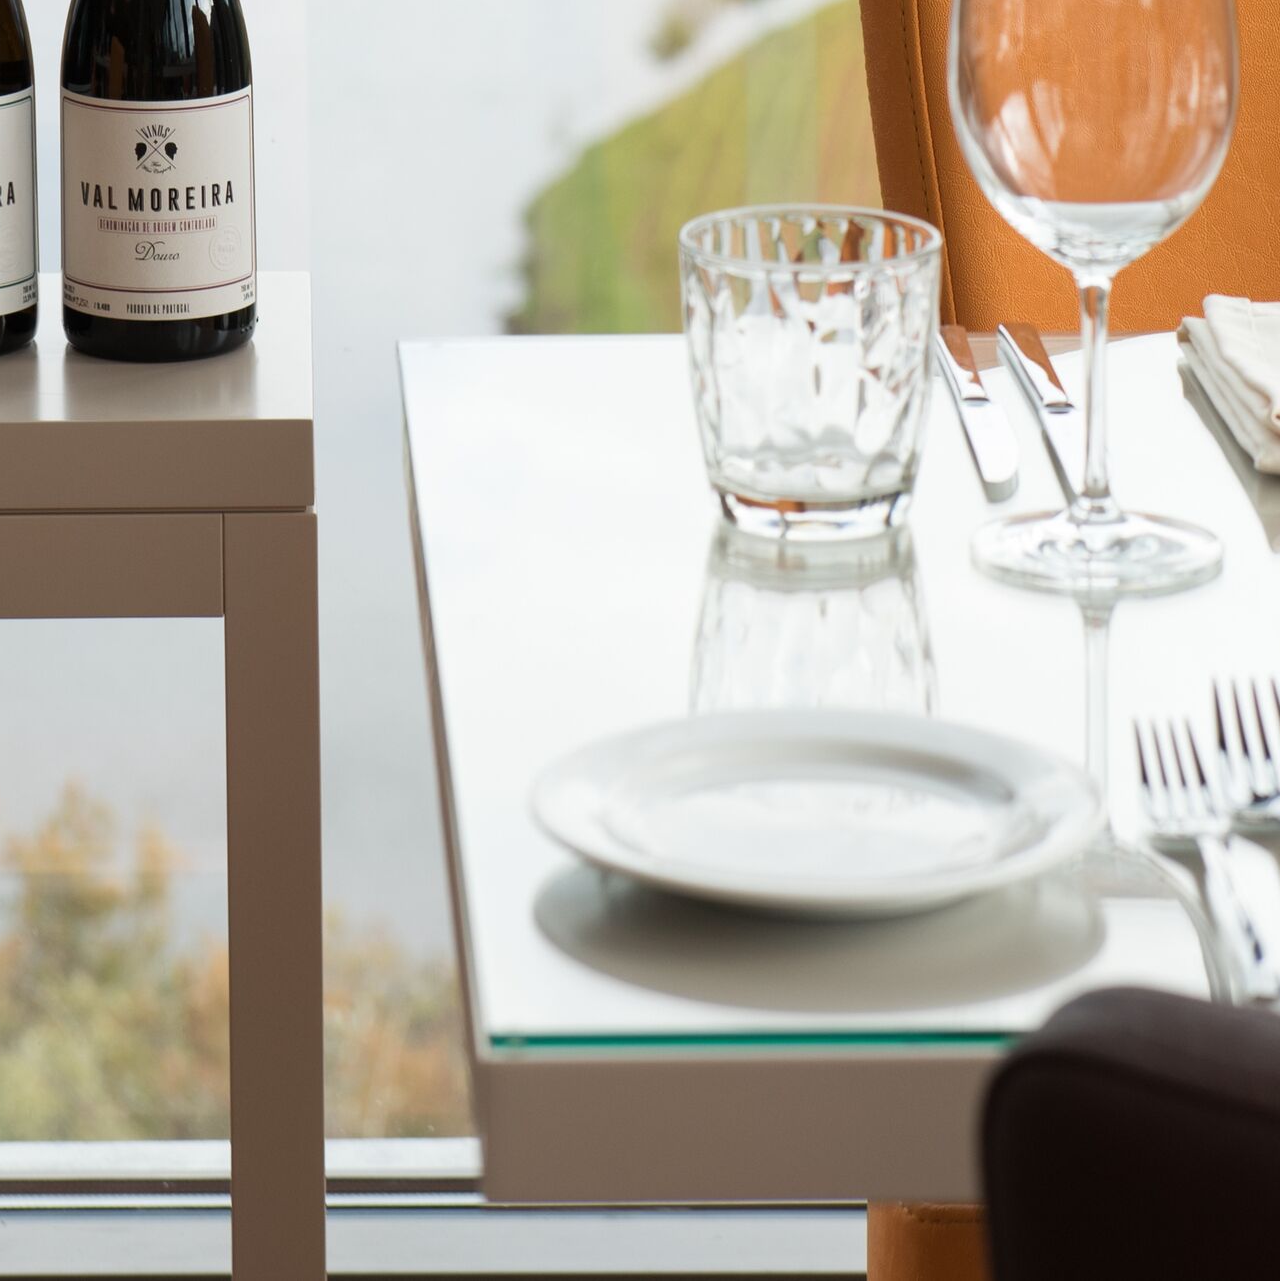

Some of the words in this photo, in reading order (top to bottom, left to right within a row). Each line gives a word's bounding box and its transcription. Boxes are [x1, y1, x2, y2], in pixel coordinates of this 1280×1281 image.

[140, 123, 171, 139] VINUS
[81, 181, 118, 210] VAL
[128, 180, 235, 212] MOREIRA
[99, 218, 140, 233] DENOMINAÇÃO
[142, 221, 150, 233] DE
[153, 220, 177, 232] ORIGEM
[179, 217, 216, 232] CONTROLADA
[134, 240, 181, 262] Douro
[126, 303, 152, 315] PRODUTO
[153, 303, 160, 314] DE
[161, 303, 191, 314] PORTUGAL
